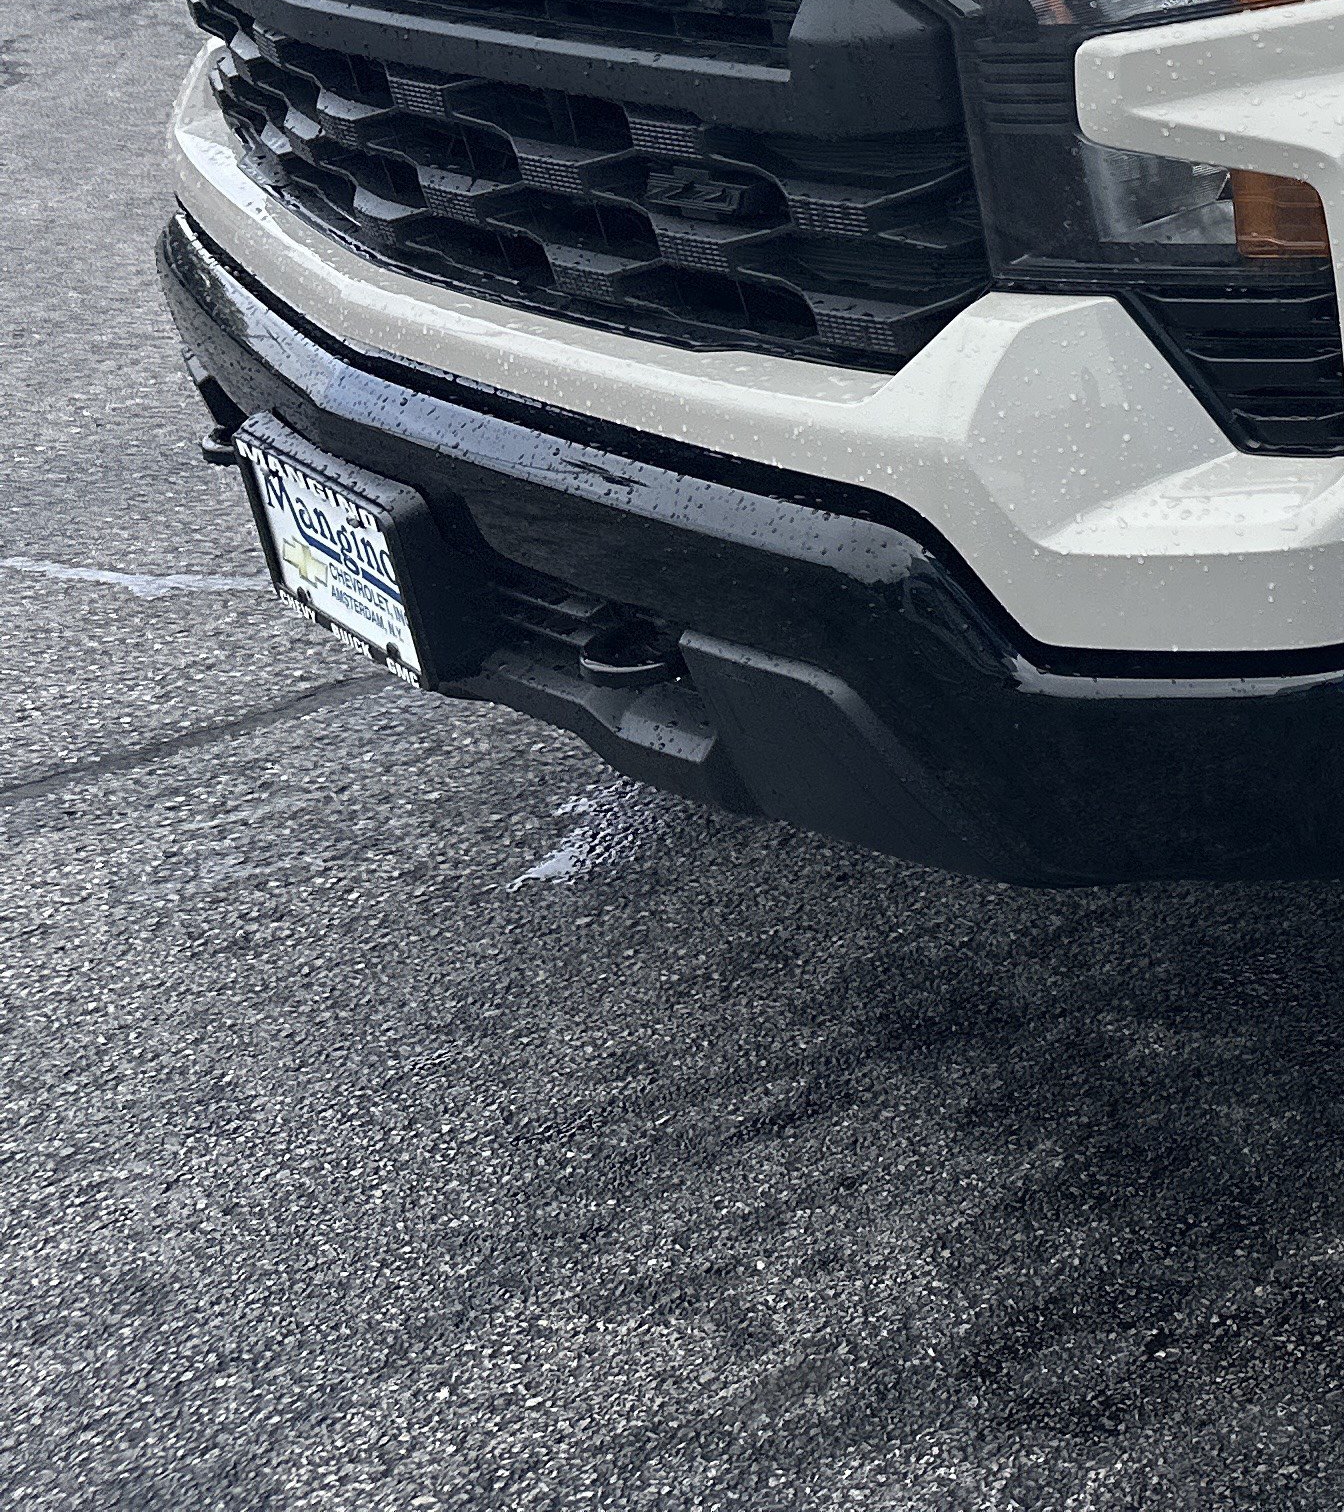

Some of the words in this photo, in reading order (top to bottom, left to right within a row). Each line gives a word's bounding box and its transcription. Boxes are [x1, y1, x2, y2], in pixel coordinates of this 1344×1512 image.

[235, 438, 379, 533] MANGINO
[263, 474, 397, 585] Mangino
[279, 589, 316, 623] CHEVY
[331, 622, 373, 659] BUICK
[386, 657, 420, 688] GMC
